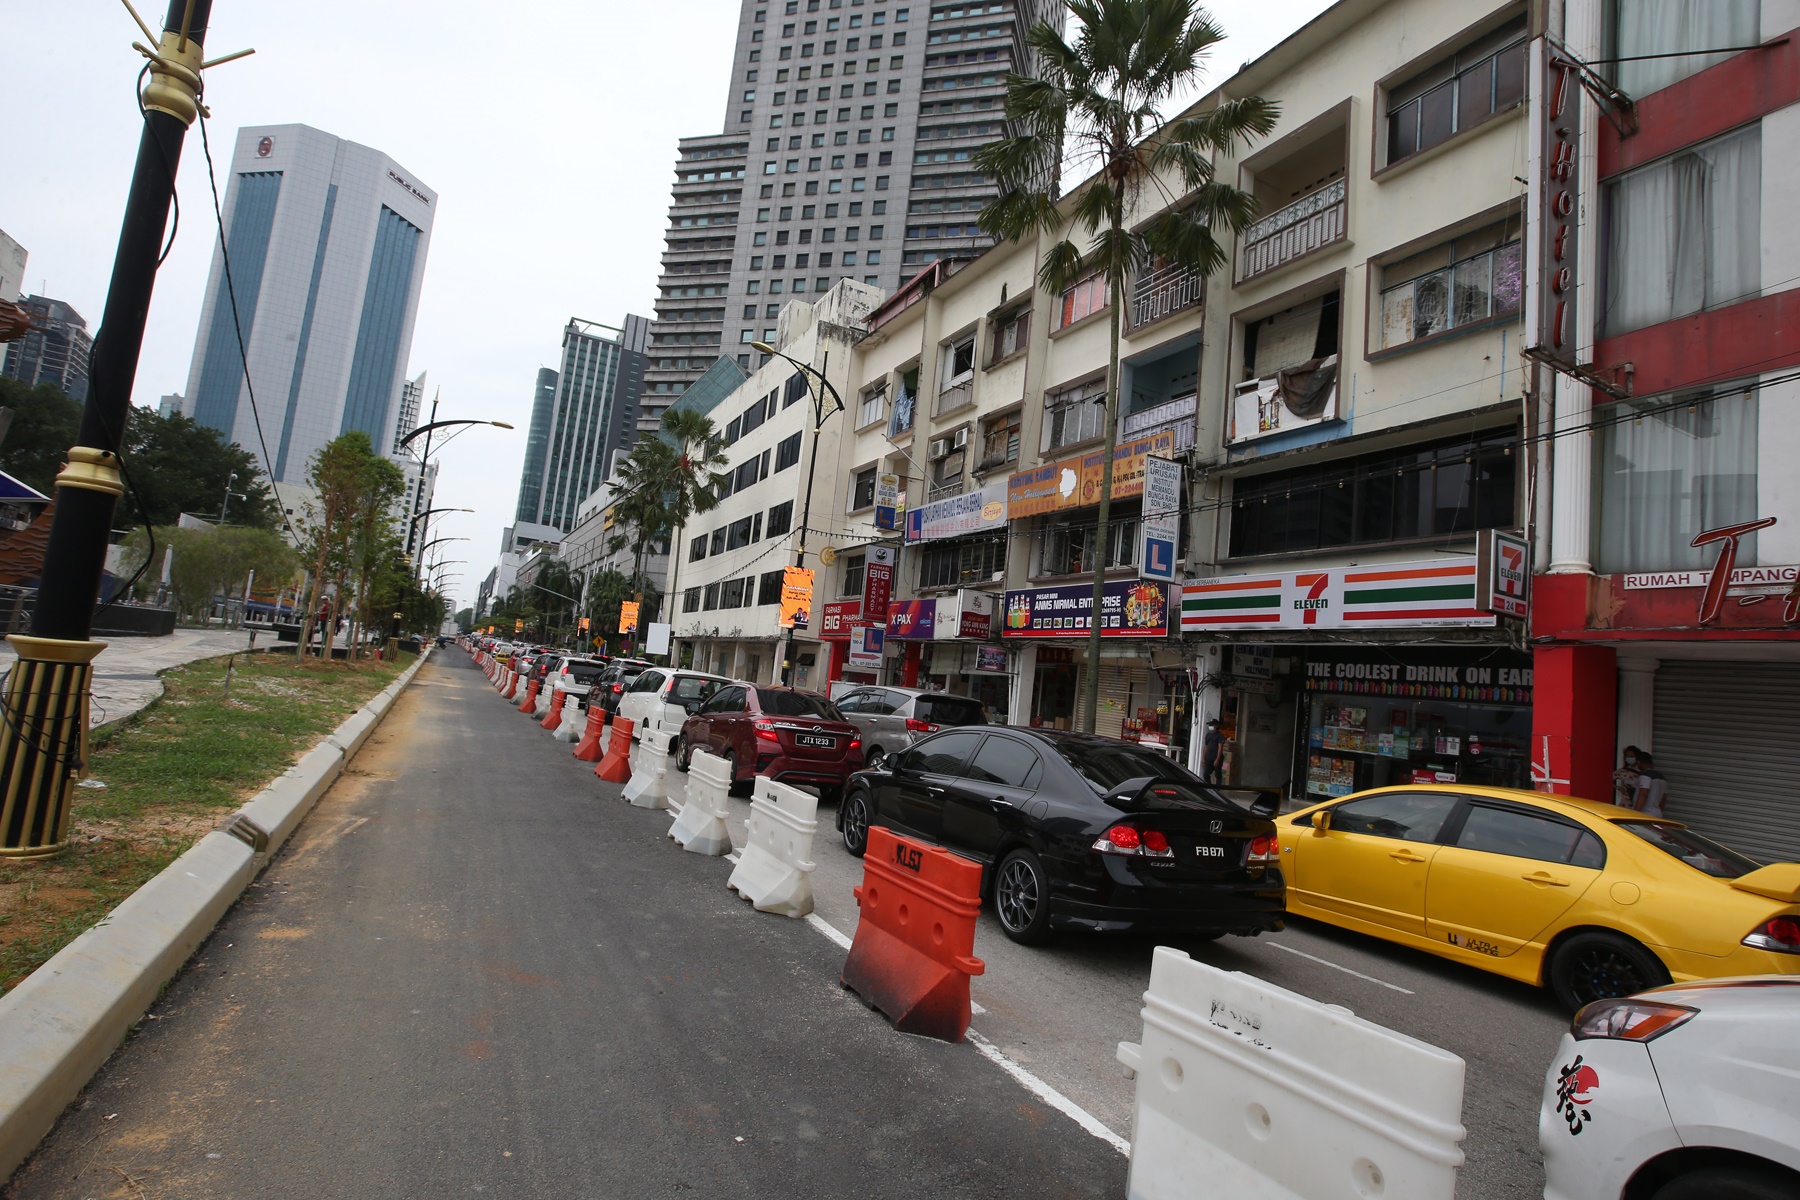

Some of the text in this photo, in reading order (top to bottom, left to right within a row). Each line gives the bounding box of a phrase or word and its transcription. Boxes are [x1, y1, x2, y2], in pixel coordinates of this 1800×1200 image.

[389, 170, 430, 205] PUBLIC BANK
[1155, 435, 1170, 450] RAYA
[1150, 460, 1179, 474] PEJABAT
[1150, 467, 1178, 481] URUSAN
[1153, 477, 1173, 487] INSTITUT
[1148, 490, 1165, 502] BUNGA
[1151, 484, 1175, 496] MEMANDU
[908, 512, 920, 539] L
[1151, 543, 1167, 572] L
[869, 569, 890, 580] BIG
[1502, 545, 1523, 596] 7
[1626, 573, 1690, 587] RUMAH
[870, 578, 878, 612] PHARMACY
[1295, 573, 1329, 625] 7
[1053, 598, 1078, 610] NIRMAL
[1506, 600, 1515, 611] 24
[824, 614, 841, 630] BIG
[1253, 656, 1264, 666] NEW
[1244, 665, 1270, 677] HOLLYWOOD
[1306, 662, 1331, 677] THE
[1335, 663, 1400, 681] COOLEST
[1405, 665, 1459, 684] DRINK
[1465, 666, 1492, 685] ON
[802, 736, 829, 746] JTX 1233
[1467, 937, 1499, 951] ULTRA
